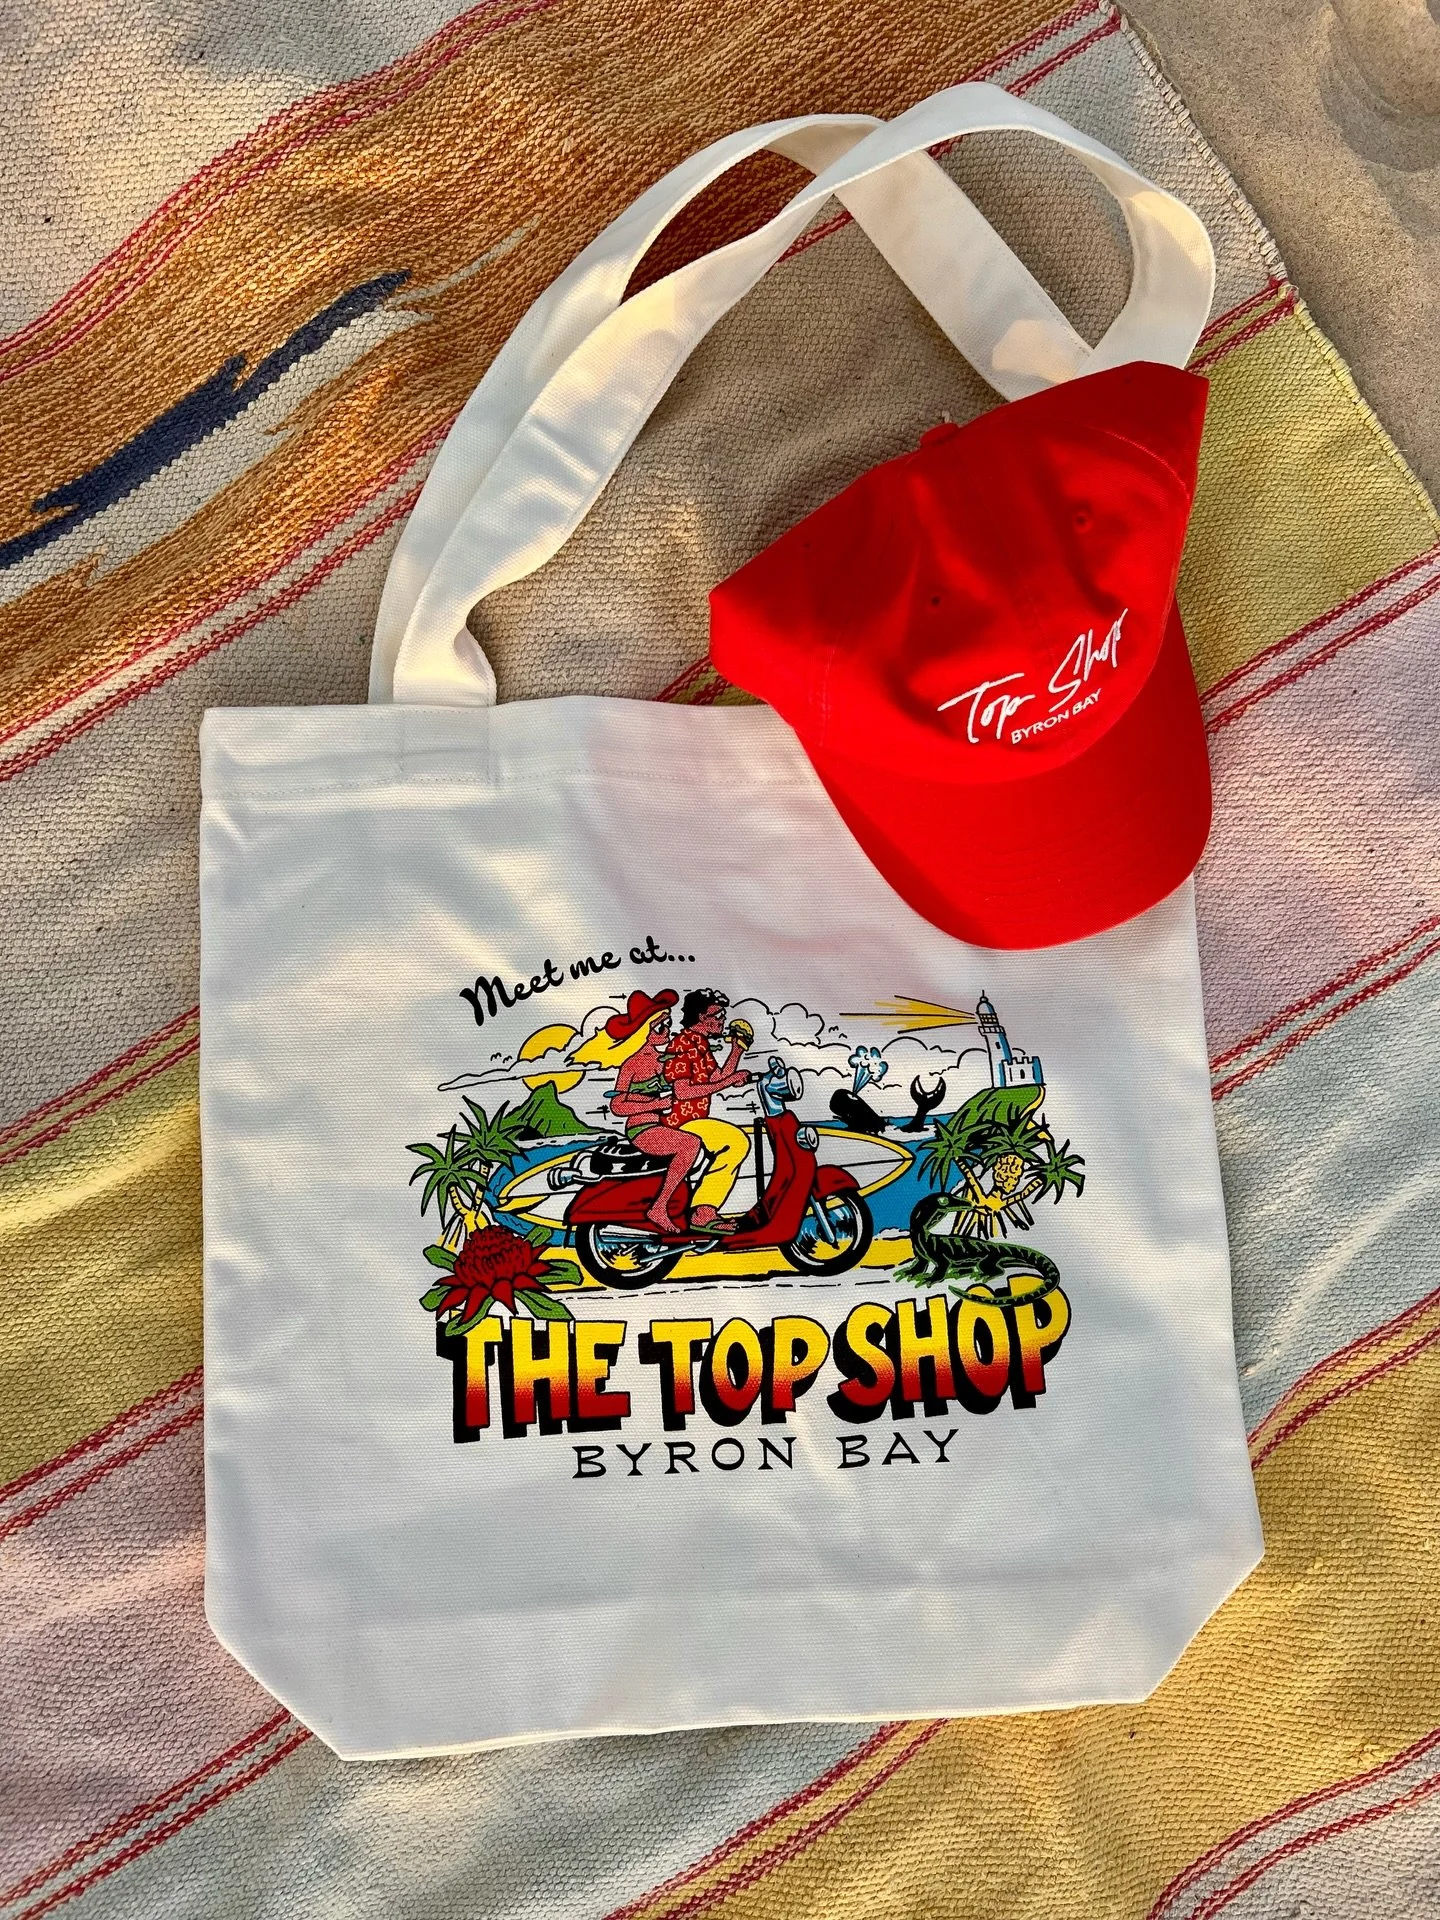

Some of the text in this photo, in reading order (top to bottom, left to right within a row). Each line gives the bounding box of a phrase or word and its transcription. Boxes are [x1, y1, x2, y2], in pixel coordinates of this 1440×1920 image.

[938, 608, 1128, 743] Top Shop
[1011, 688, 1101, 744] BYRON BAY
[459, 935, 696, 1026] Meet me at...
[437, 1275, 1071, 1443] THE TOP SHOP
[573, 1429, 959, 1478] BYRON BAY
